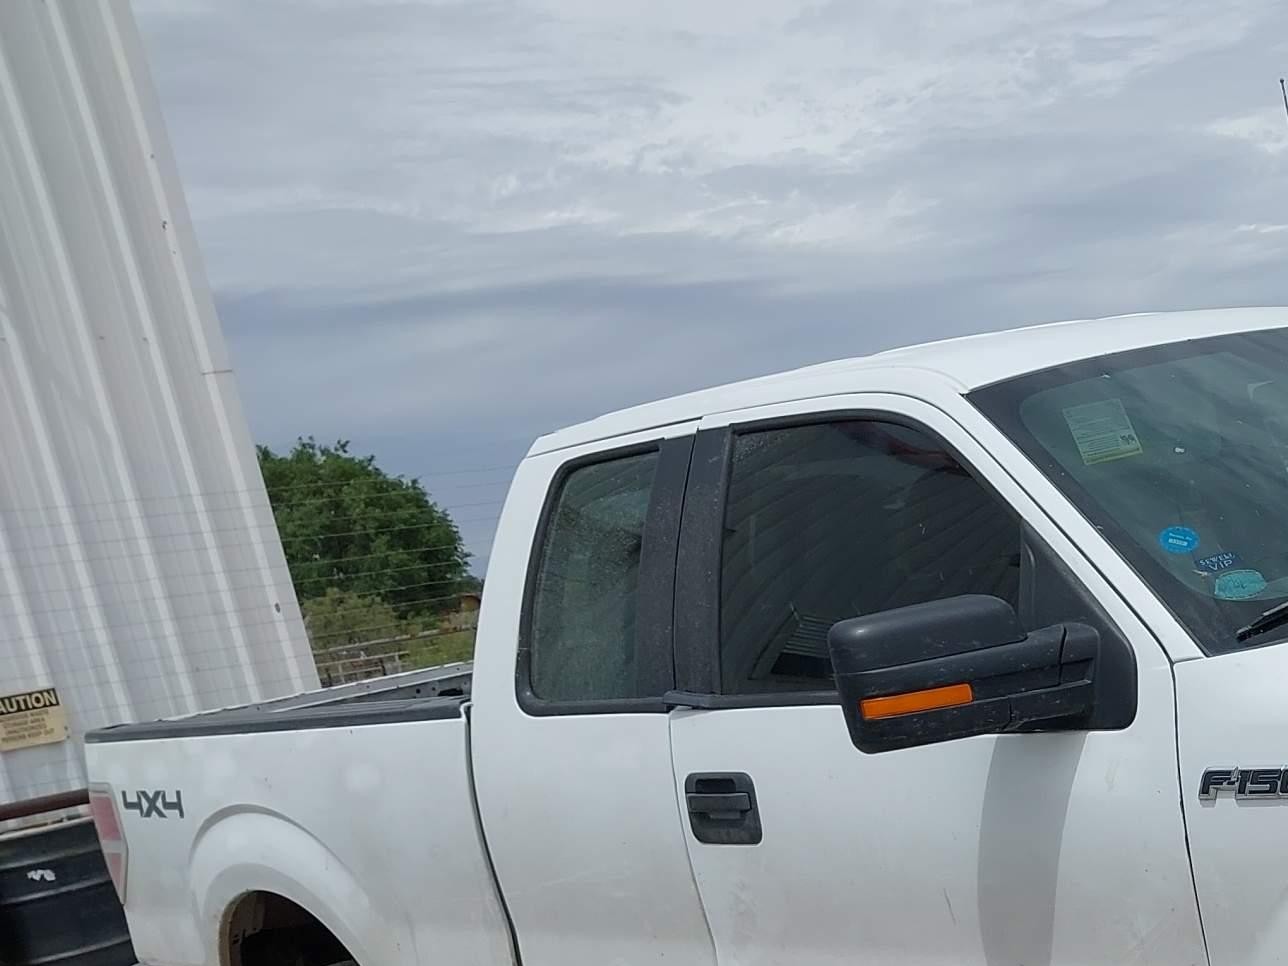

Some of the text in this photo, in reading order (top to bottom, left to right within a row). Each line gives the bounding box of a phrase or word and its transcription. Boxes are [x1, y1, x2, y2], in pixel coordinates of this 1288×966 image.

[1209, 559, 1233, 571] VIP
[0, 690, 57, 714] AUTION
[121, 790, 185, 818] 4X4
